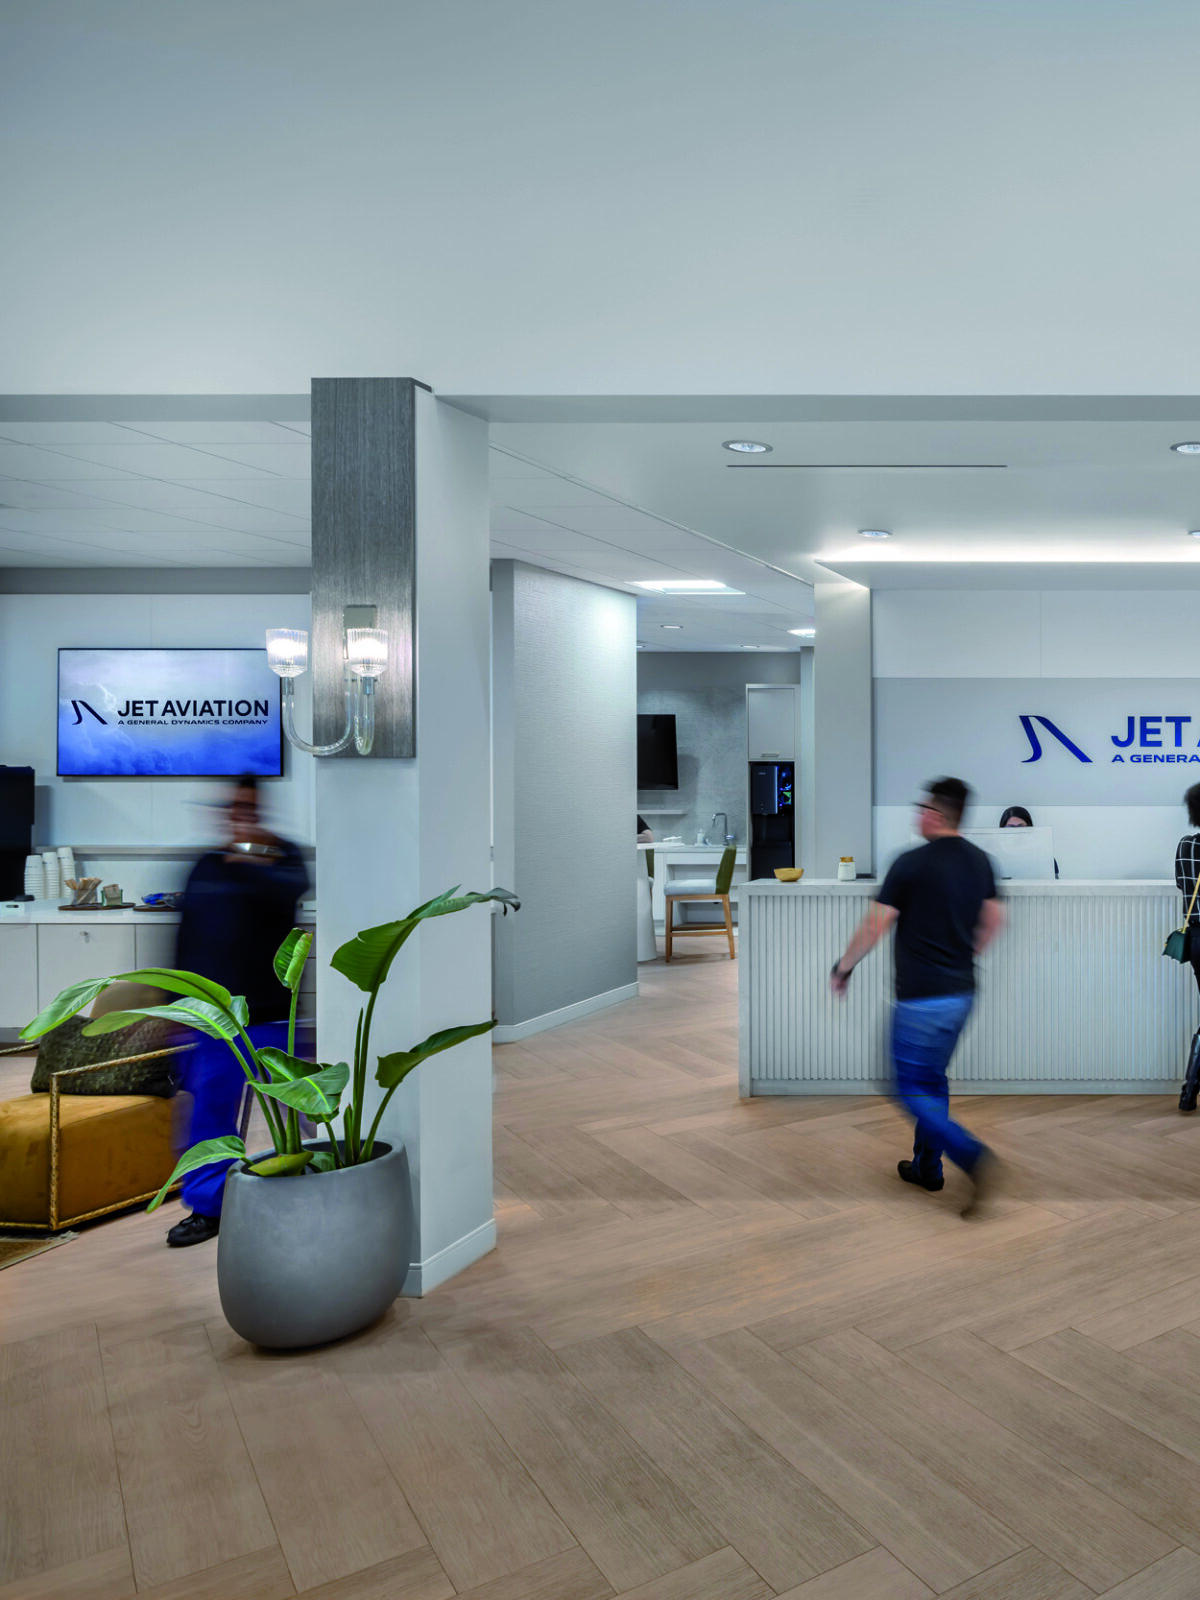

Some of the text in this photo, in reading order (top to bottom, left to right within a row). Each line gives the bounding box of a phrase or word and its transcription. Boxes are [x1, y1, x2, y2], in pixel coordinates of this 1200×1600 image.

[117, 700, 269, 717] JET AVIATION
[1110, 715, 1192, 749] JET
[1111, 754, 1126, 763] A
